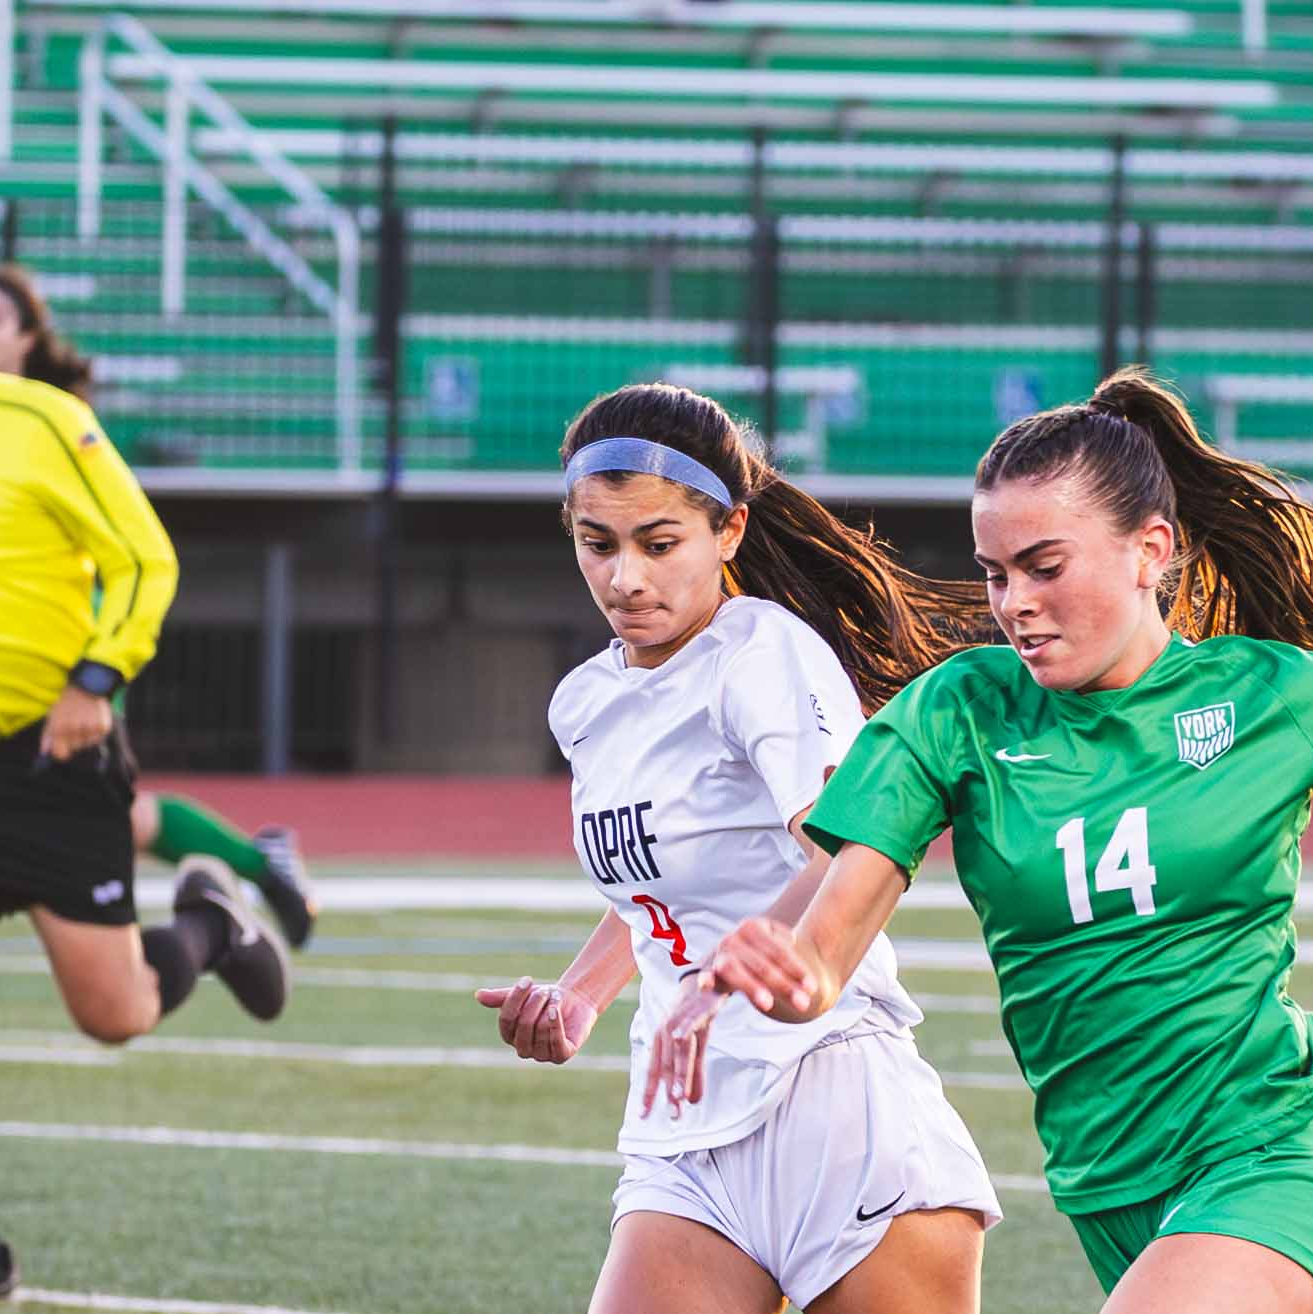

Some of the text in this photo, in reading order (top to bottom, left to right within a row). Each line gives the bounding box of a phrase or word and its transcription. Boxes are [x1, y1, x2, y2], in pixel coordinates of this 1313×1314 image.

[1180, 708, 1227, 740] YORK
[581, 800, 662, 885] OPRF
[1055, 806, 1157, 924] 14
[631, 894, 693, 967] 9
